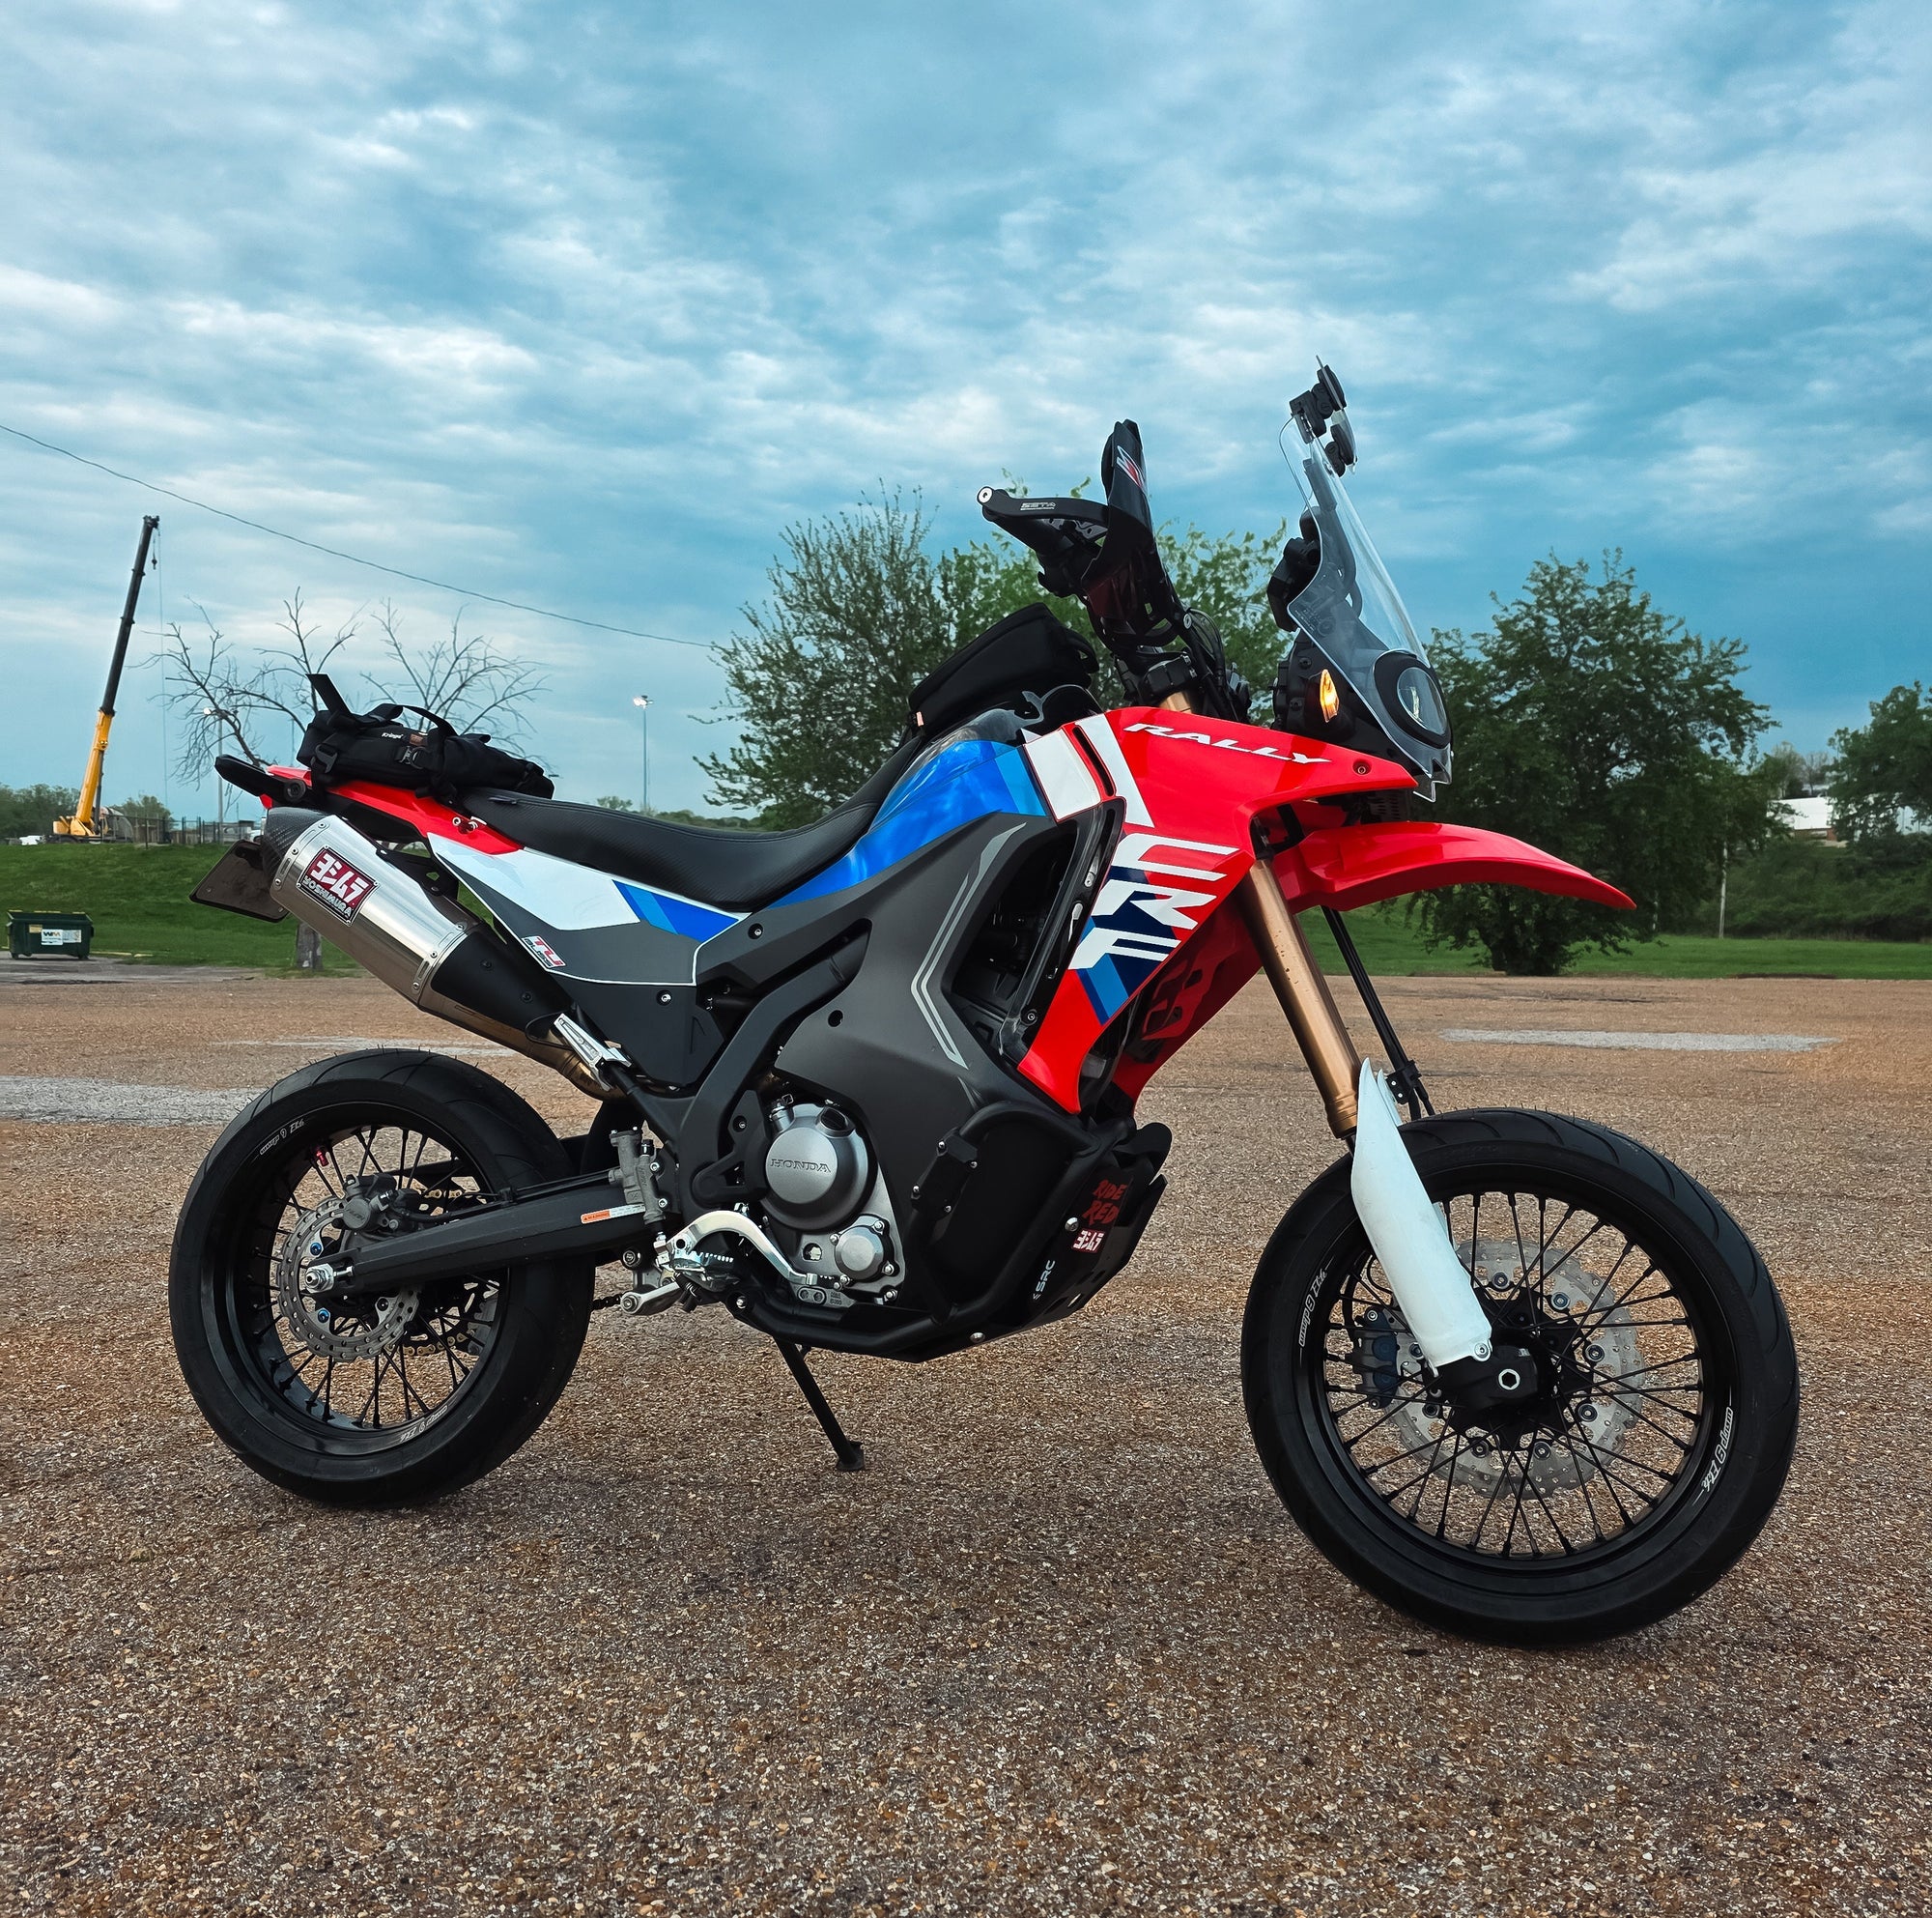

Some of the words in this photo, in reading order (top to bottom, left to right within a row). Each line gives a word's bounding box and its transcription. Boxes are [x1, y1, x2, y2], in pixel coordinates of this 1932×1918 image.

[1123, 723, 1332, 764] RALLY
[302, 875, 354, 917] YOSHIMURA
[310, 852, 369, 903] ヨシムラ
[1067, 832, 1240, 971] CRF
[770, 1159, 832, 1173] HONDA
[1093, 1179, 1128, 1200] RIDE
[1082, 1199, 1120, 1225] RED
